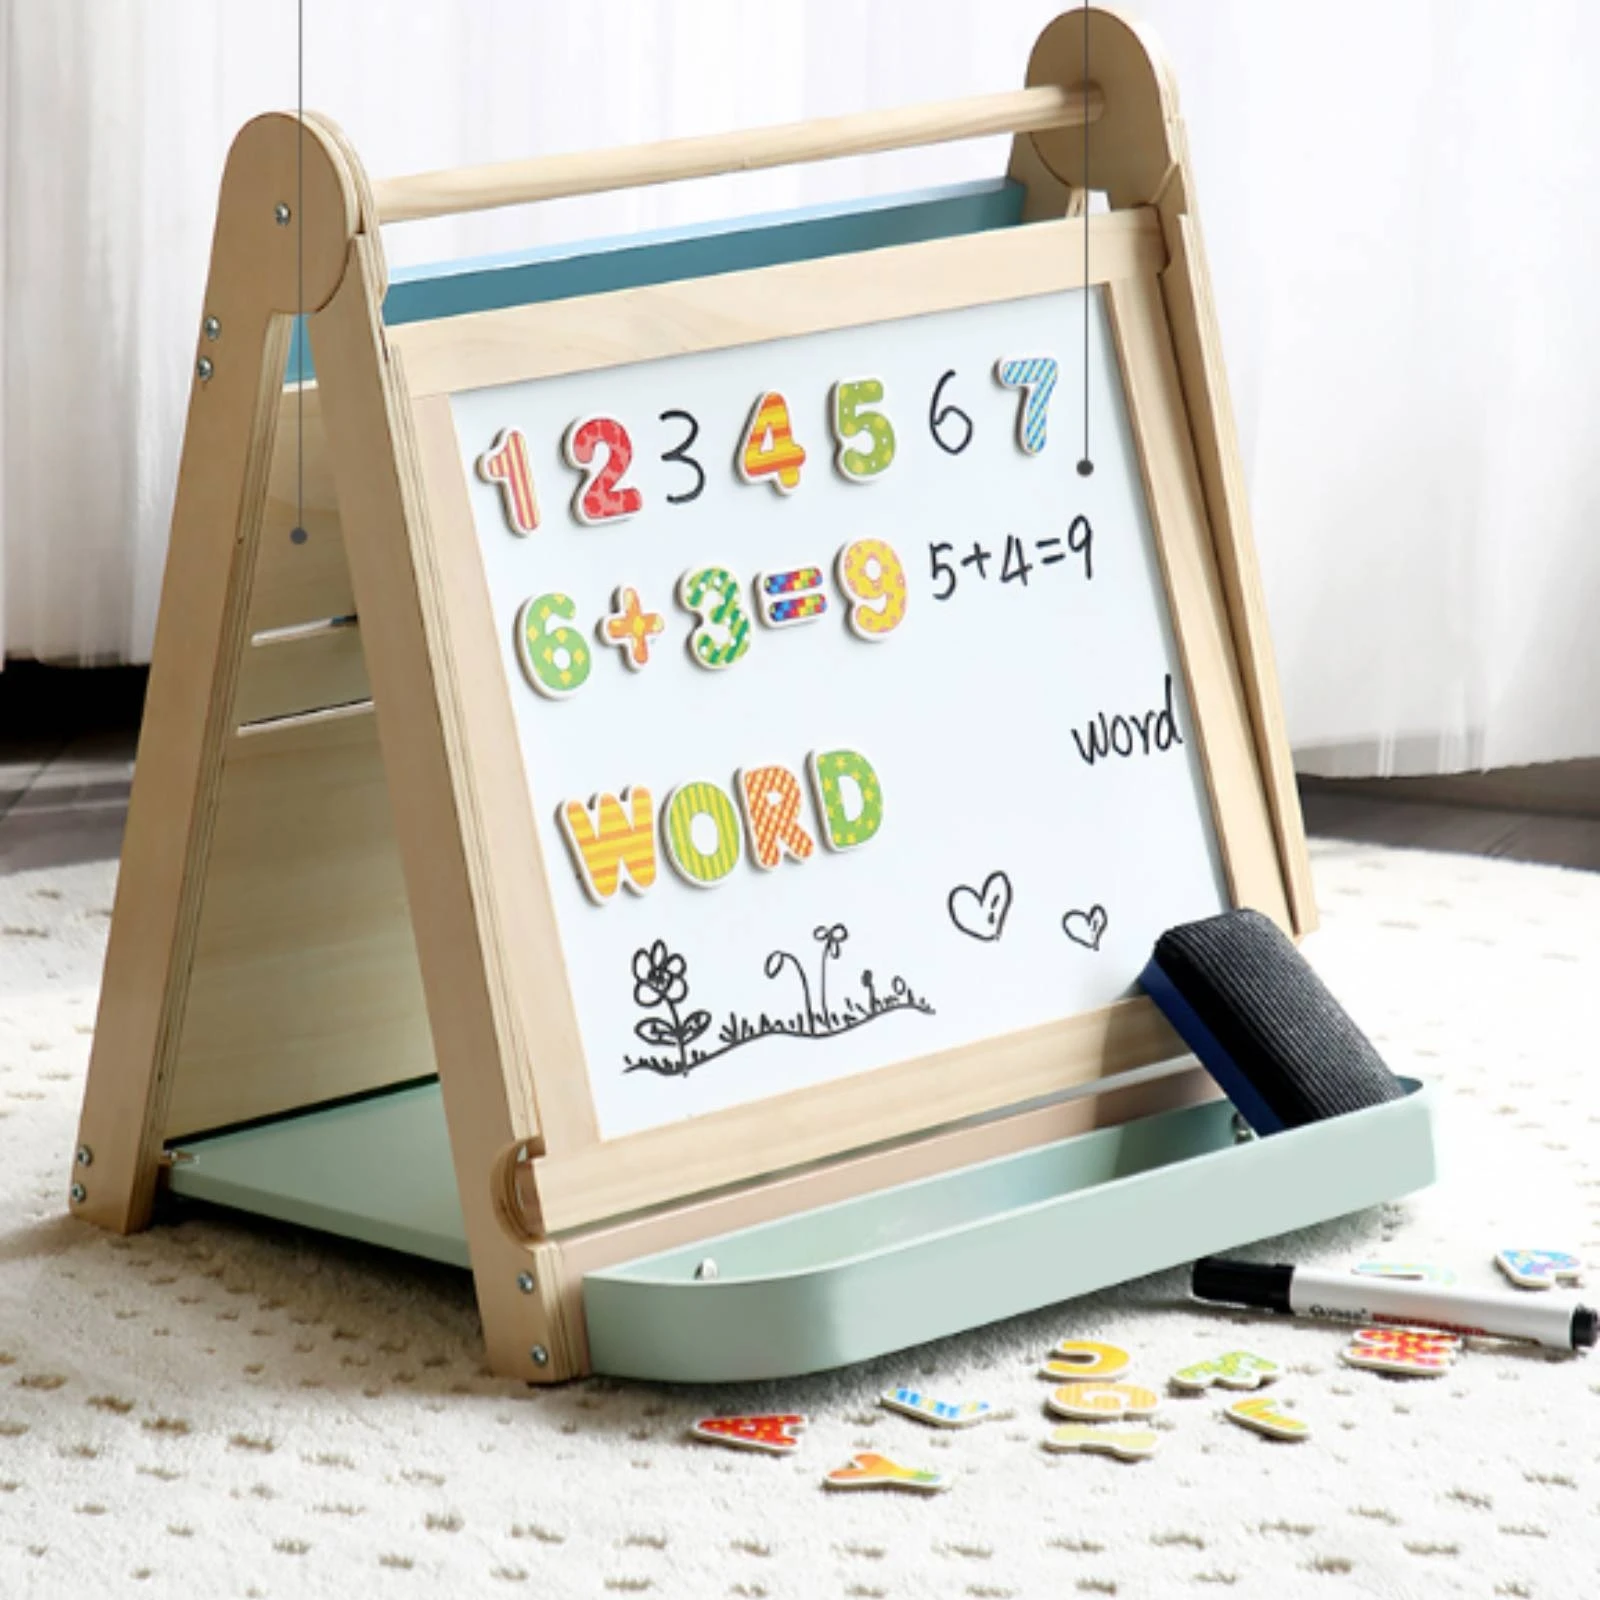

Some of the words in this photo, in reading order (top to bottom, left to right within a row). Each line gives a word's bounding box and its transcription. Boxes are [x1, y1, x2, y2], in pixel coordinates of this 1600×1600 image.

[477, 427, 541, 536] 1
[565, 412, 643, 526] 2
[659, 409, 706, 503] 3
[737, 391, 806, 496] 4
[831, 377, 897, 483] 5
[929, 369, 974, 454] 6
[994, 356, 1059, 455] 7
[928, 514, 1095, 601] 5+4=9
[1071, 674, 1184, 767] word
[556, 748, 884, 906] WORD
[692, 1412, 807, 1452] A
